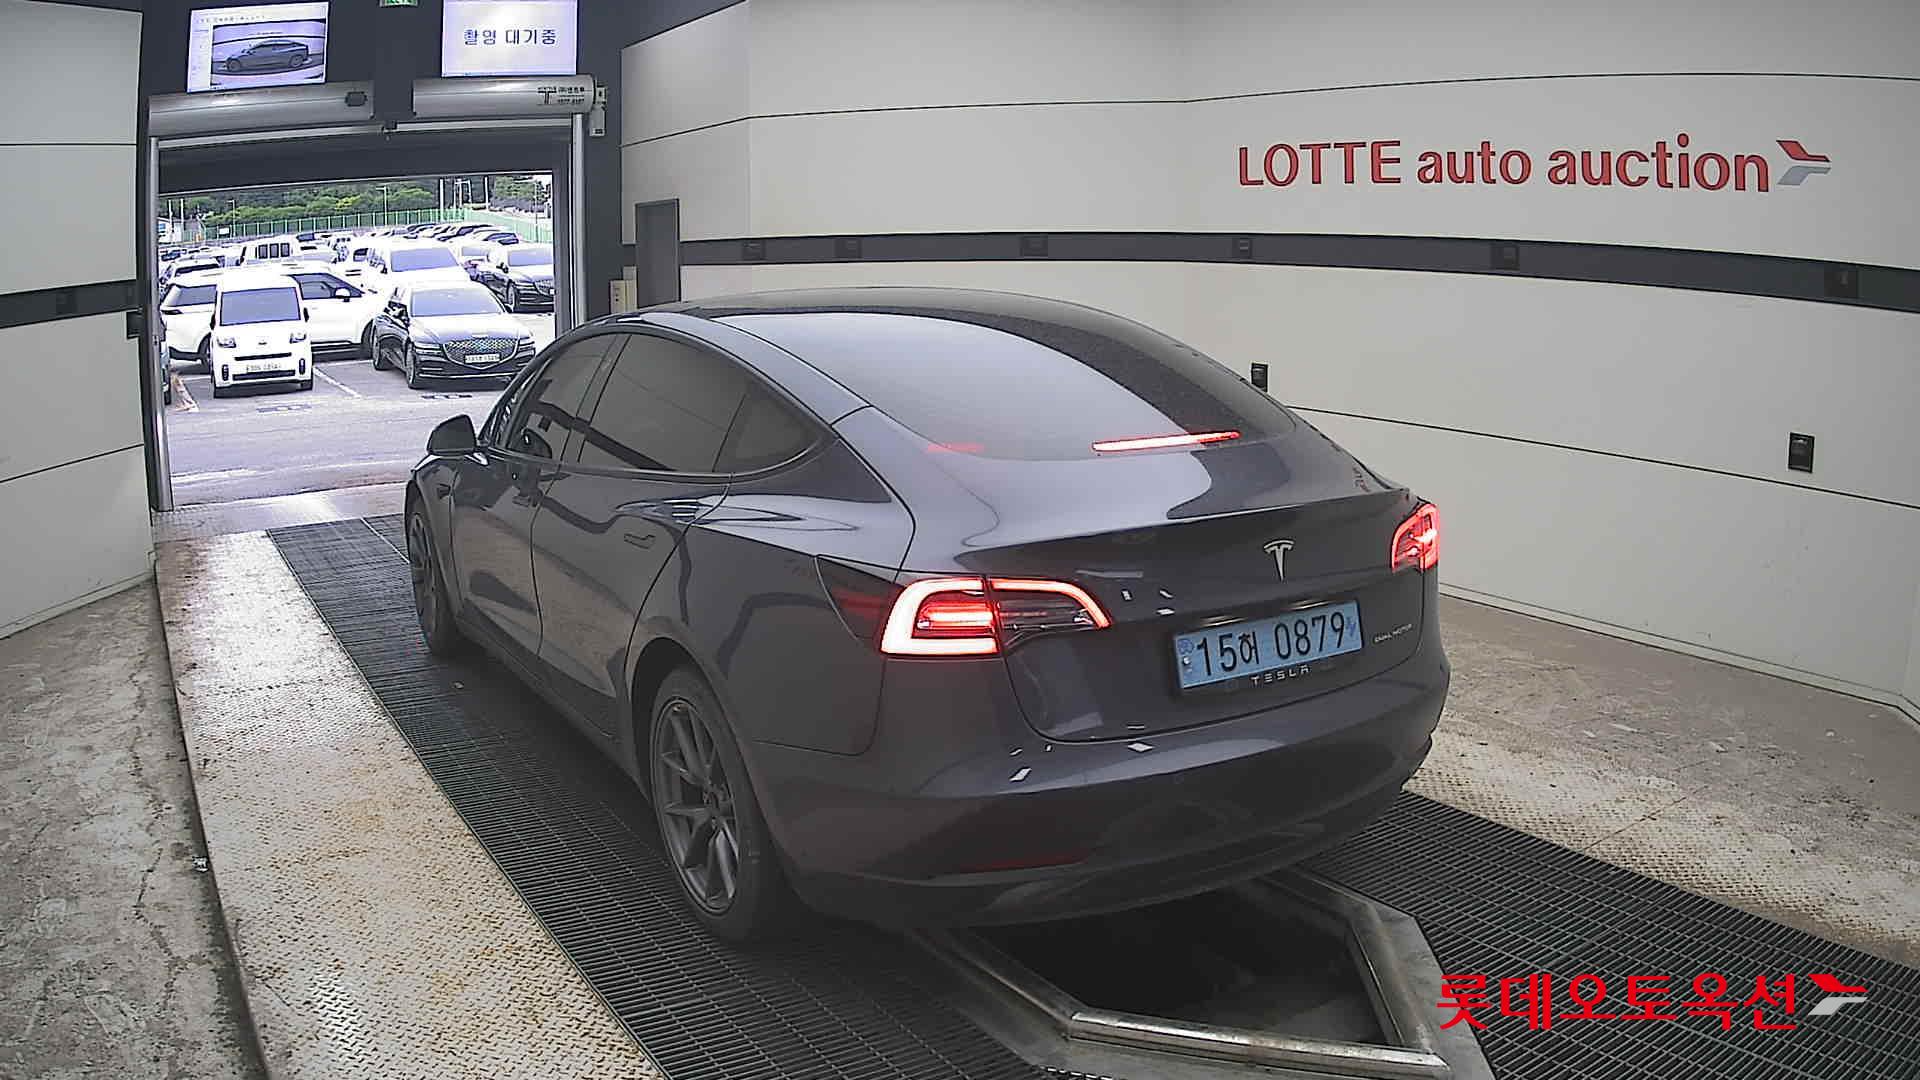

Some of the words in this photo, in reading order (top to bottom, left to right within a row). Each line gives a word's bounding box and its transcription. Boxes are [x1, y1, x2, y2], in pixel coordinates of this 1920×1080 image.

[464, 29, 496, 45] 촬영
[505, 29, 556, 45] 대기중
[1238, 140, 1401, 187] LOTTE
[1416, 140, 1532, 185] auto
[1547, 133, 1769, 192] auction
[1196, 630, 1259, 676] 15허
[1274, 611, 1345, 660] 0879
[1251, 664, 1311, 687] TESLA
